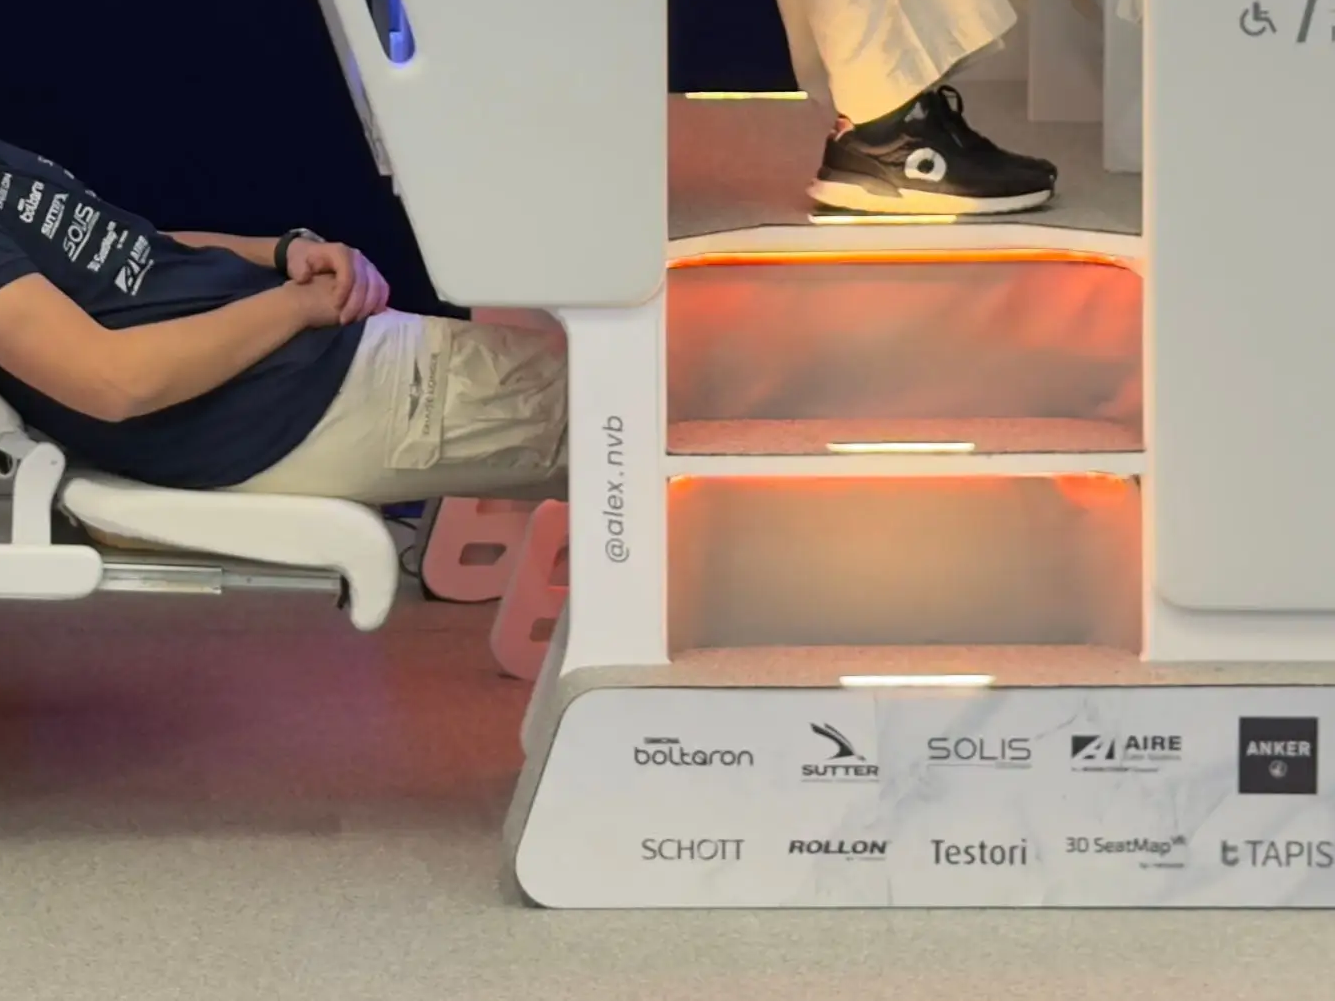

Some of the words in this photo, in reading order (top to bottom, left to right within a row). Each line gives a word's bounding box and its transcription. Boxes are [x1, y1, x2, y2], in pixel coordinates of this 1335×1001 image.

[602, 415, 631, 564] @alex.nvb
[927, 737, 1032, 760] SOLIS
[1124, 735, 1182, 751] AIRE
[1246, 740, 1311, 757] ANKER
[634, 746, 754, 766] boltaron
[801, 764, 879, 776] SUTTER
[641, 838, 745, 860] SCHOTT
[788, 839, 888, 855] ROLLON
[931, 838, 1027, 866] Testori
[1066, 836, 1089, 853] 3D
